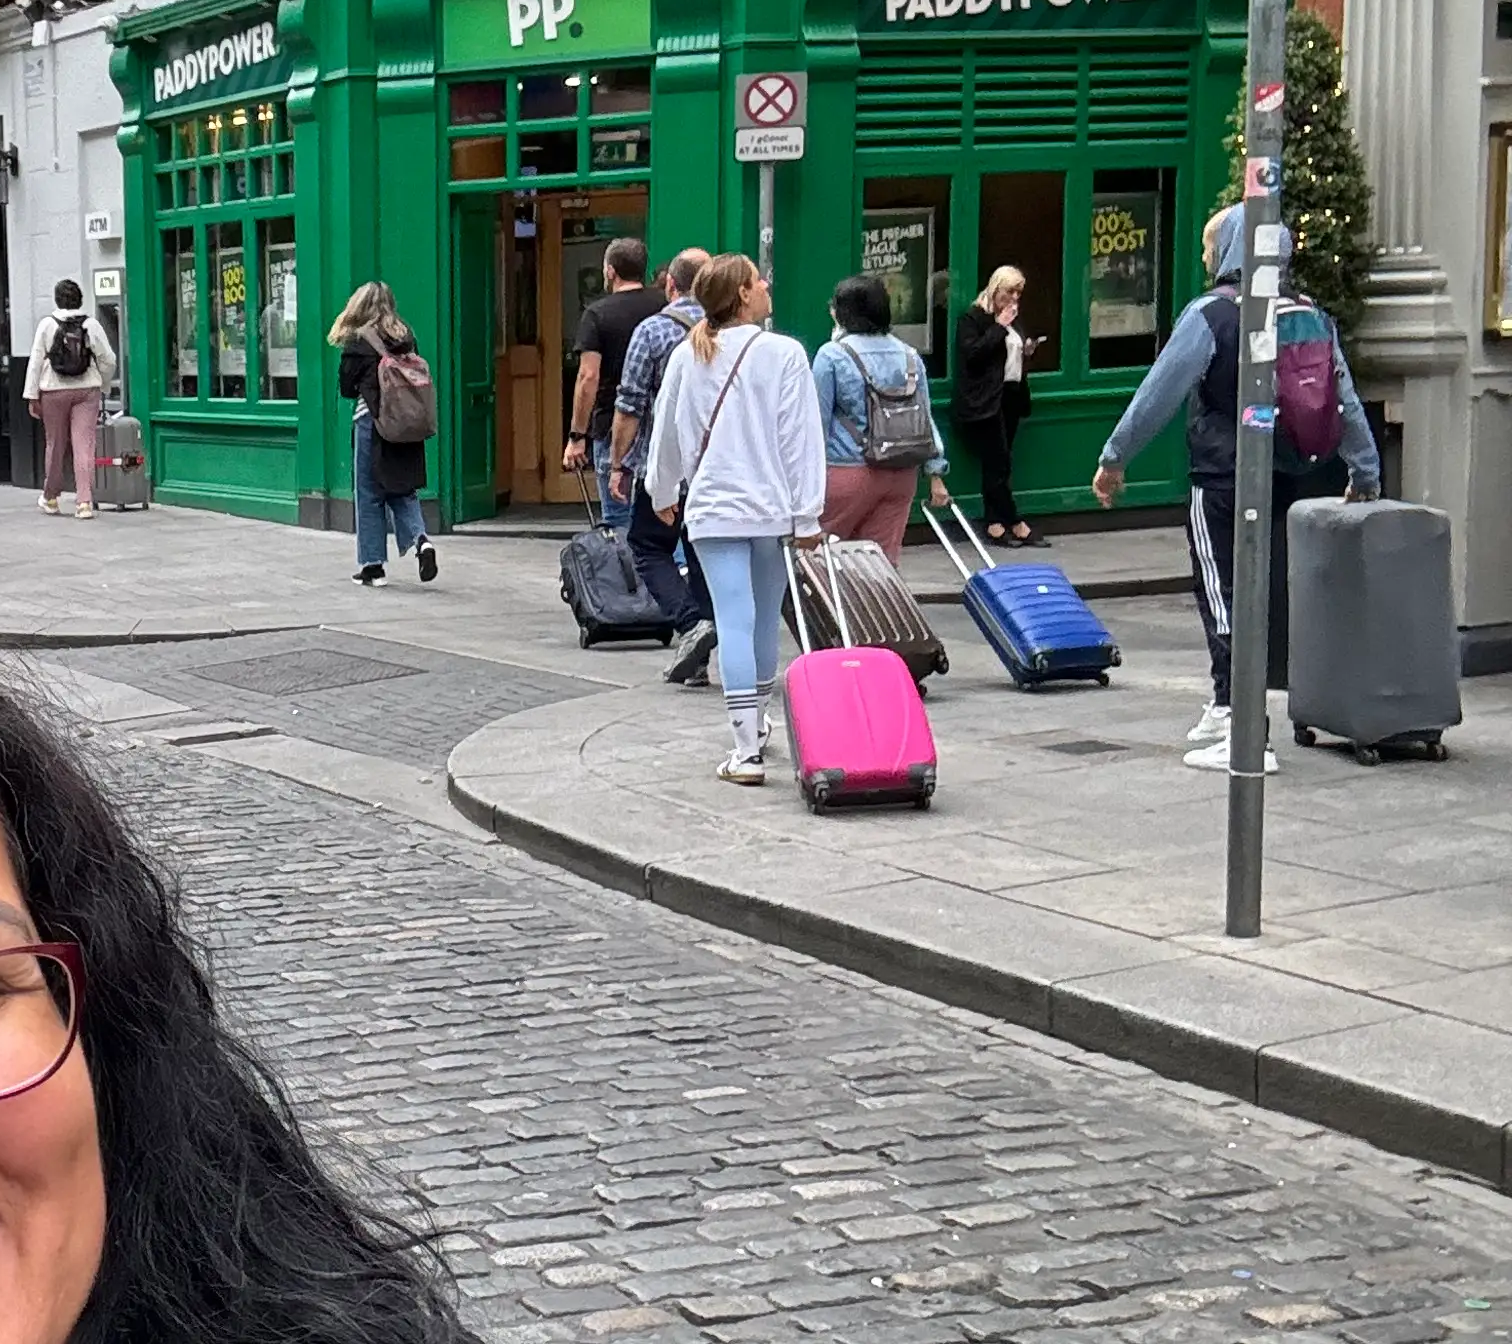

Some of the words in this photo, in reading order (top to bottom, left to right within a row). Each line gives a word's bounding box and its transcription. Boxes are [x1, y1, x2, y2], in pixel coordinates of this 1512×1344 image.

[753, 146, 769, 154] ALL
[772, 144, 800, 153] TIMES
[89, 217, 108, 233] ATM
[100, 276, 116, 288] ATM
[224, 284, 246, 305] BOO
